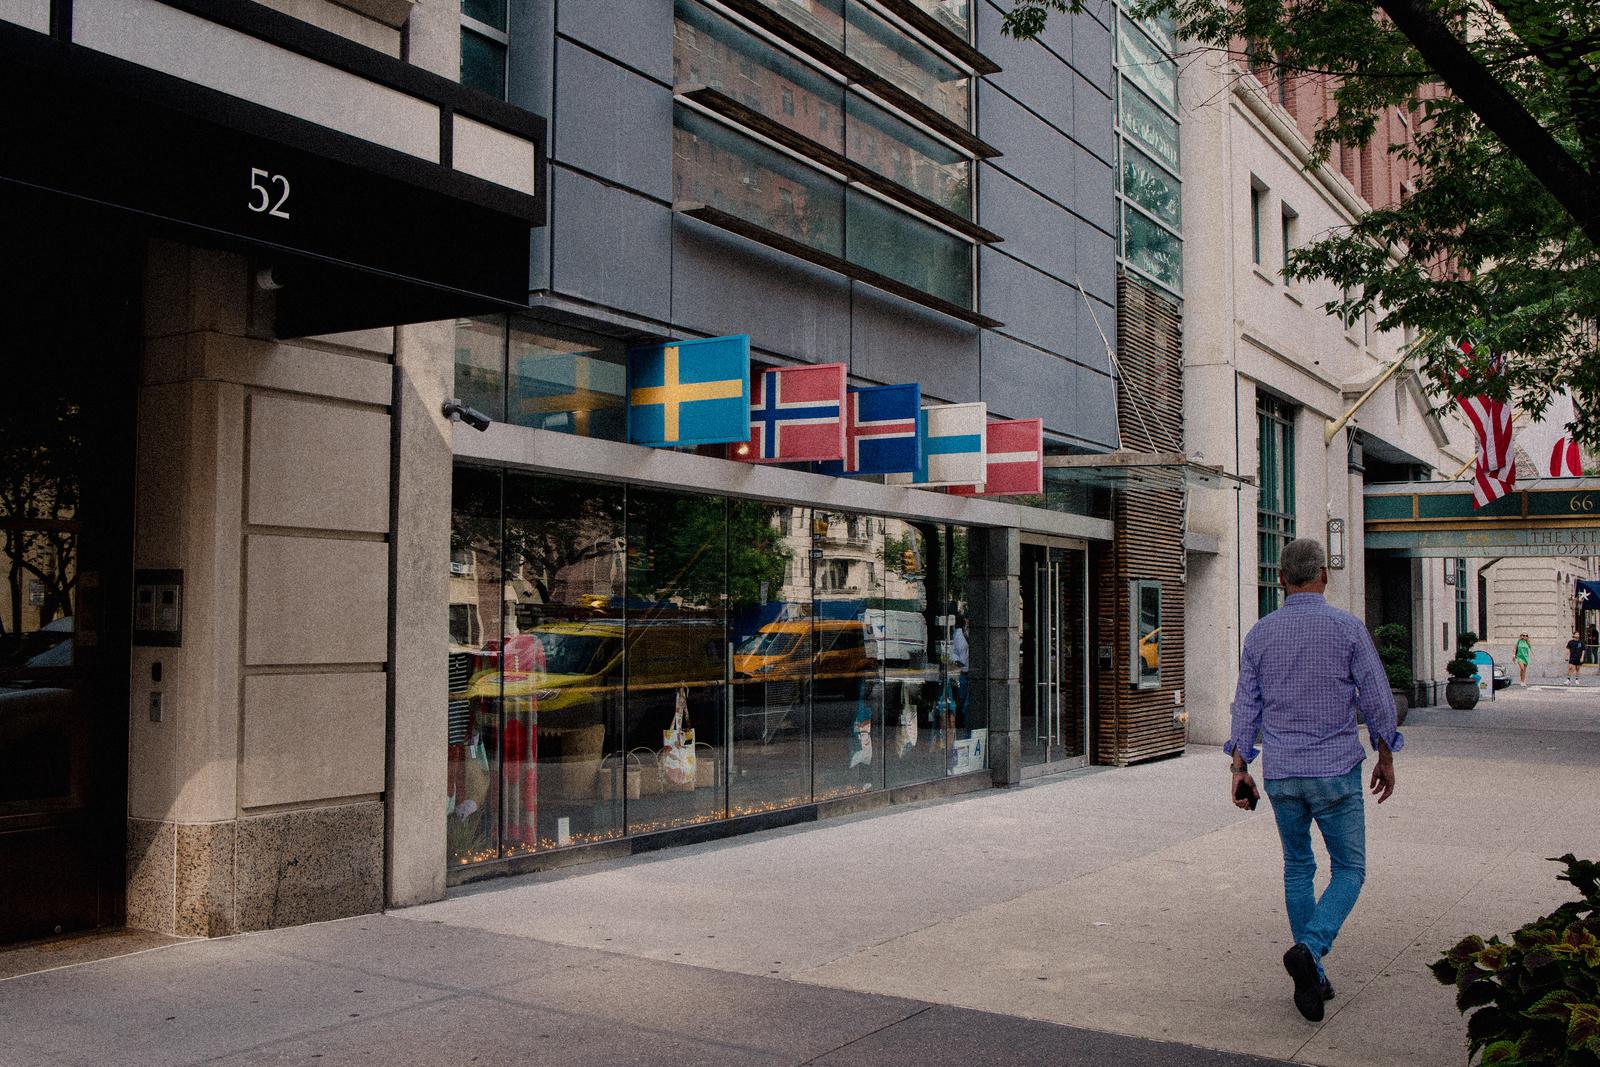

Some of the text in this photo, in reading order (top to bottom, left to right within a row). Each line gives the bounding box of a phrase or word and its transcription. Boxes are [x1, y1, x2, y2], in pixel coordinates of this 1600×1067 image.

[247, 167, 290, 220] 52
[1570, 495, 1593, 511] 66
[1531, 531, 1562, 543] THE
[974, 739, 981, 756] A
